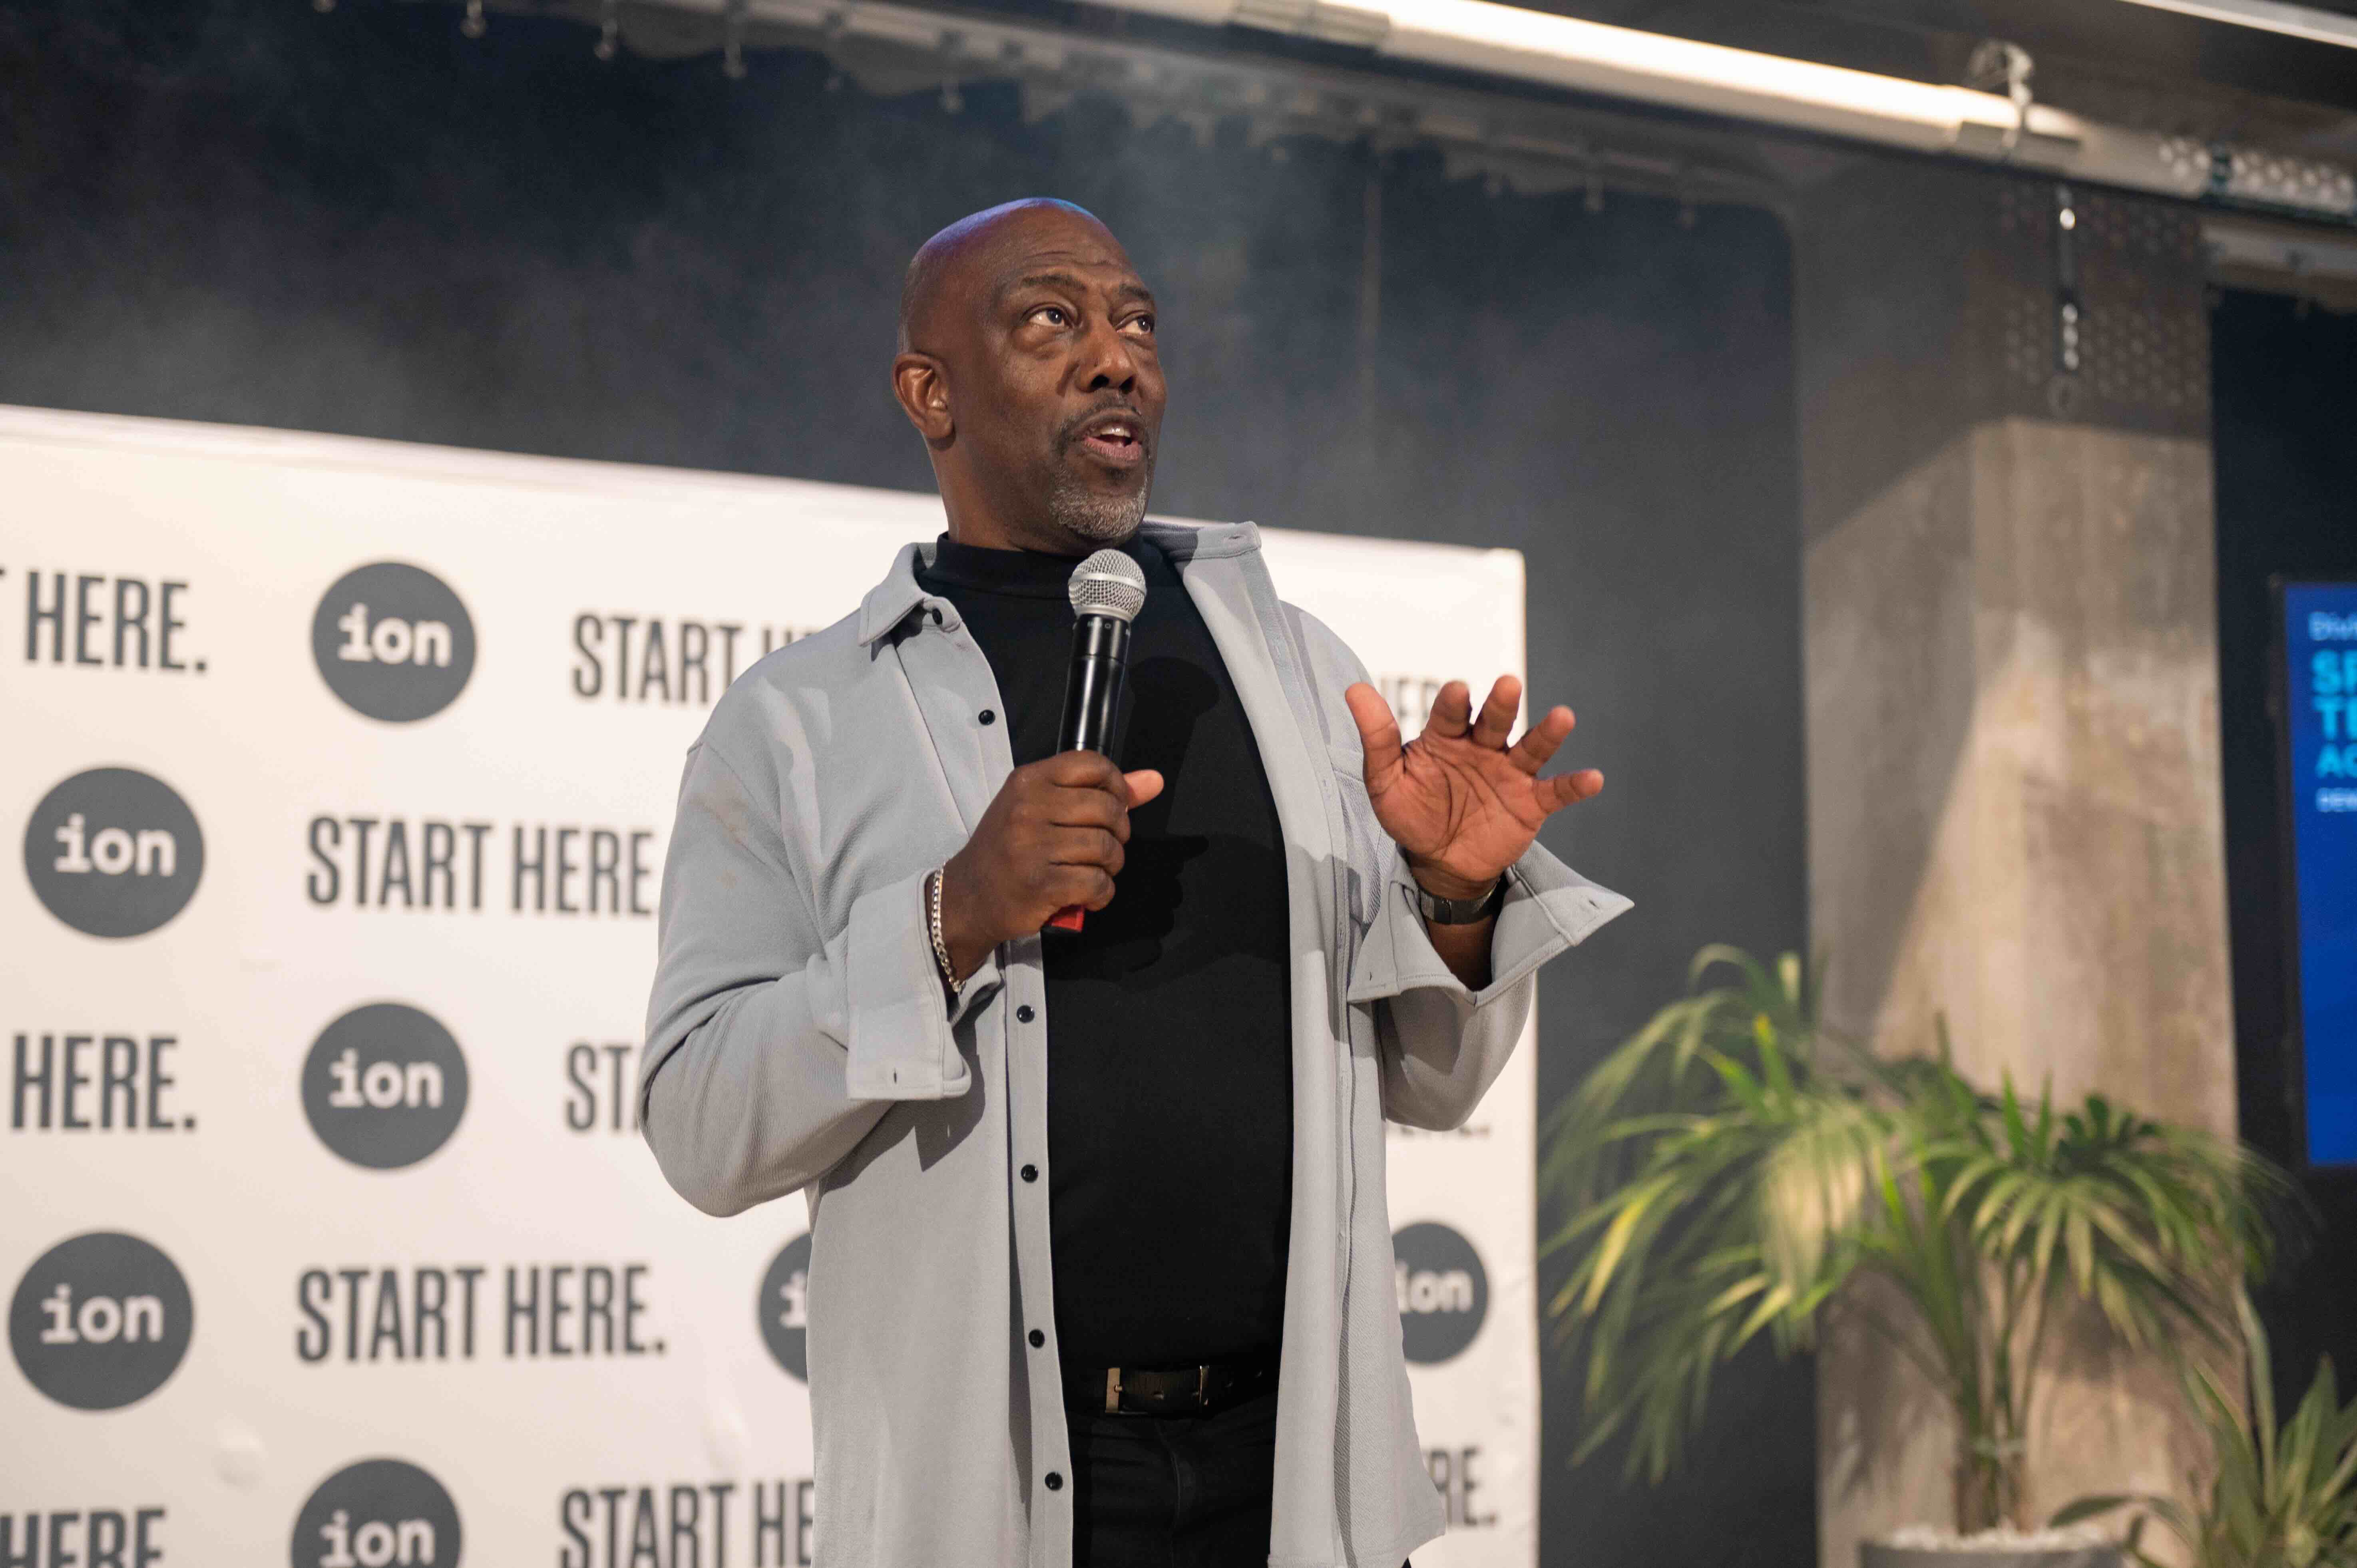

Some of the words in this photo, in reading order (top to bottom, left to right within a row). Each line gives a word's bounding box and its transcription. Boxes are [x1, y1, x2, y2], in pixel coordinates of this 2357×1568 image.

[25, 570, 207, 673] HERE.
[340, 604, 451, 666] ion
[573, 612, 743, 704] START
[56, 814, 176, 876] ion
[307, 815, 492, 911] START
[11, 1033, 196, 1131] HERE.
[330, 1049, 443, 1107] ion
[42, 1284, 163, 1343] ion
[297, 1267, 485, 1364] START
[504, 1264, 665, 1358] HERE.
[320, 1510, 436, 1567] ion
[559, 1481, 737, 1568] START
